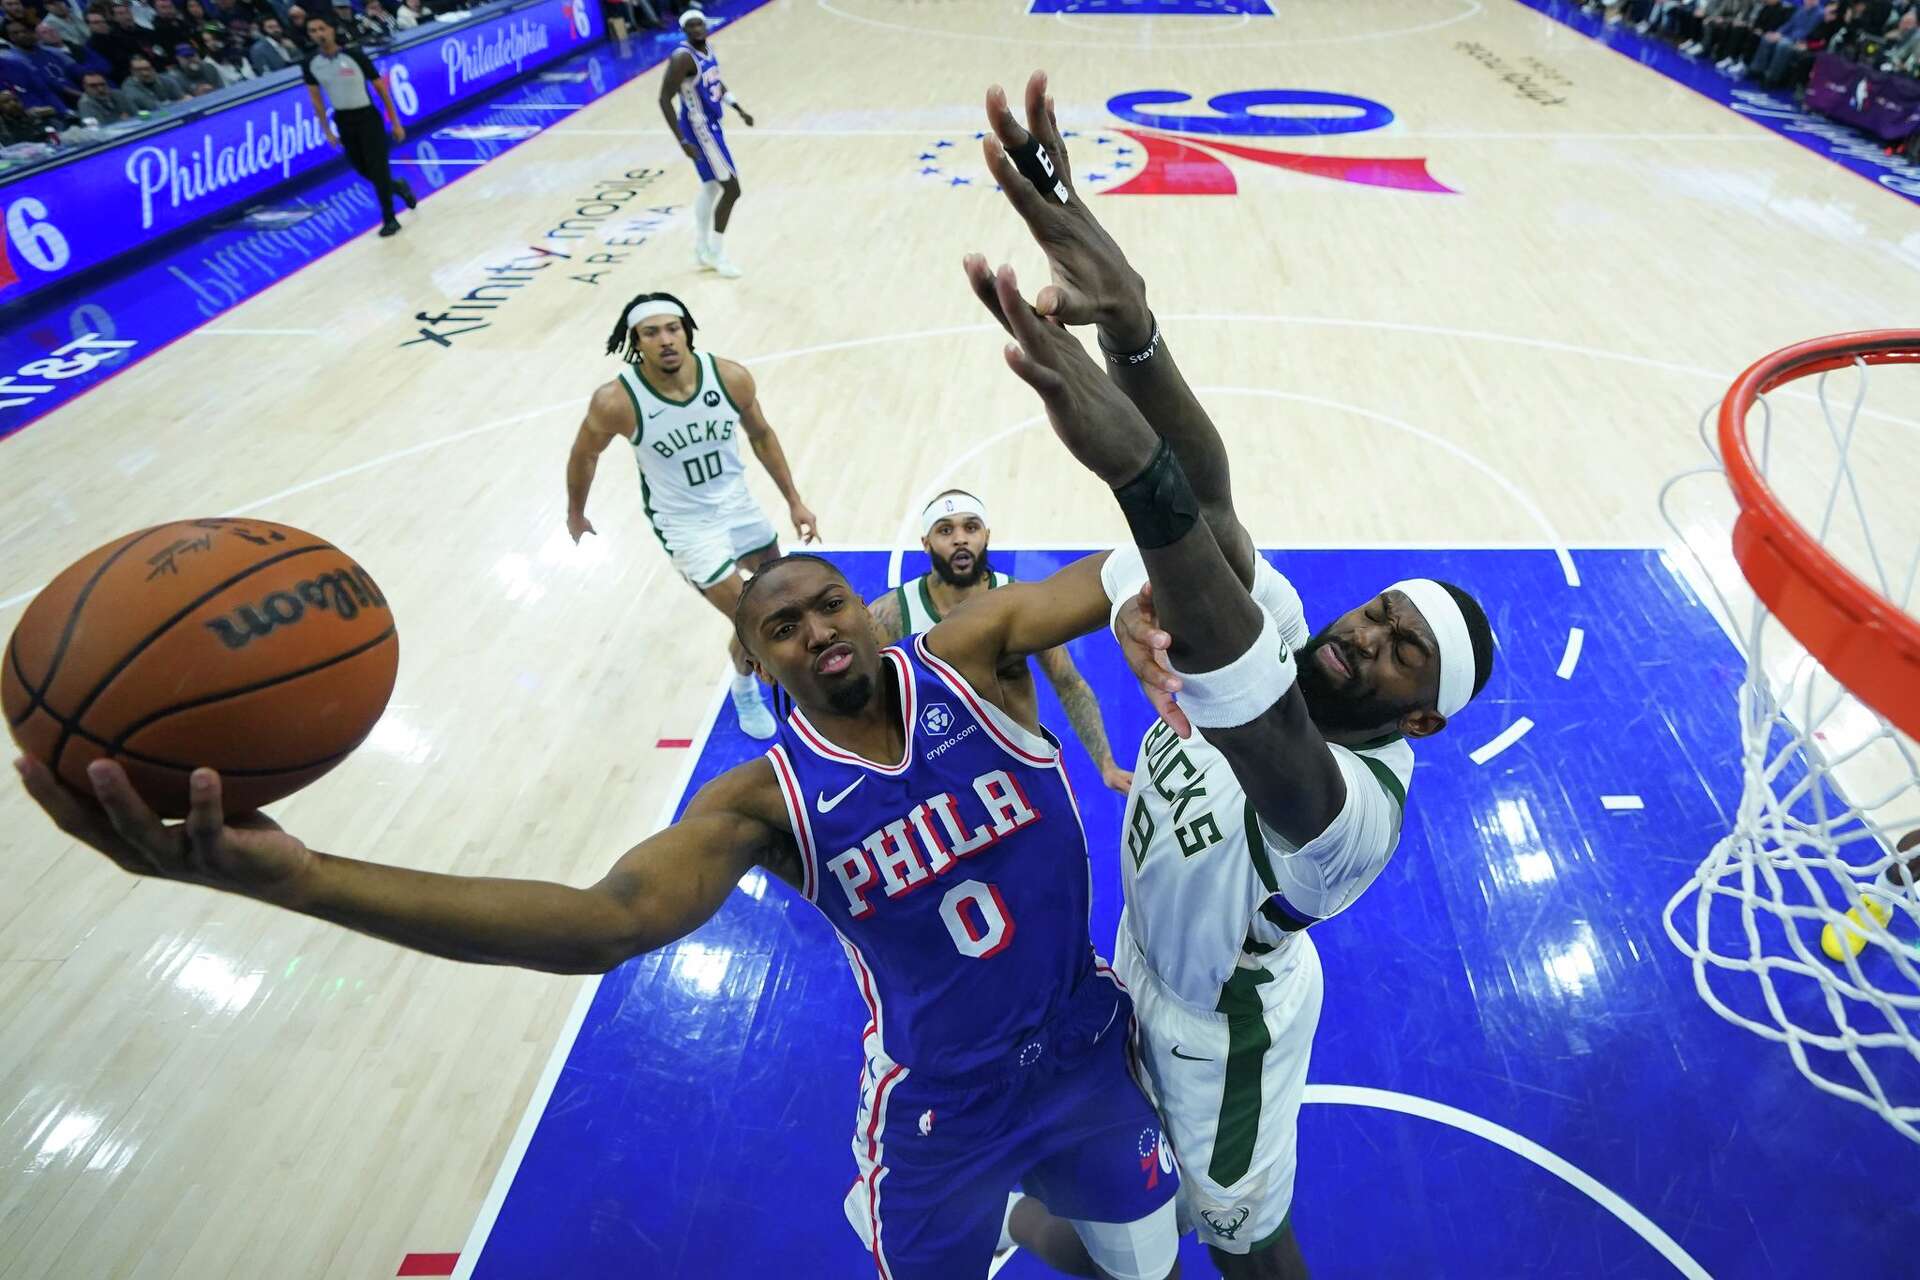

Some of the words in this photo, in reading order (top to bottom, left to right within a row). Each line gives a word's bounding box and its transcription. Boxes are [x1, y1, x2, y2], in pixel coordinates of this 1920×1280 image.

[440, 18, 549, 96] Philadelphia
[126, 102, 341, 229] Philadelphi
[567, 203, 682, 286] ARENA
[1129, 345, 1154, 364] Stay
[651, 419, 734, 459] BUCKS
[682, 450, 724, 487] 00
[926, 721, 978, 762] crypto.com
[825, 768, 1041, 921] PHILA
[937, 878, 1016, 960] 0
